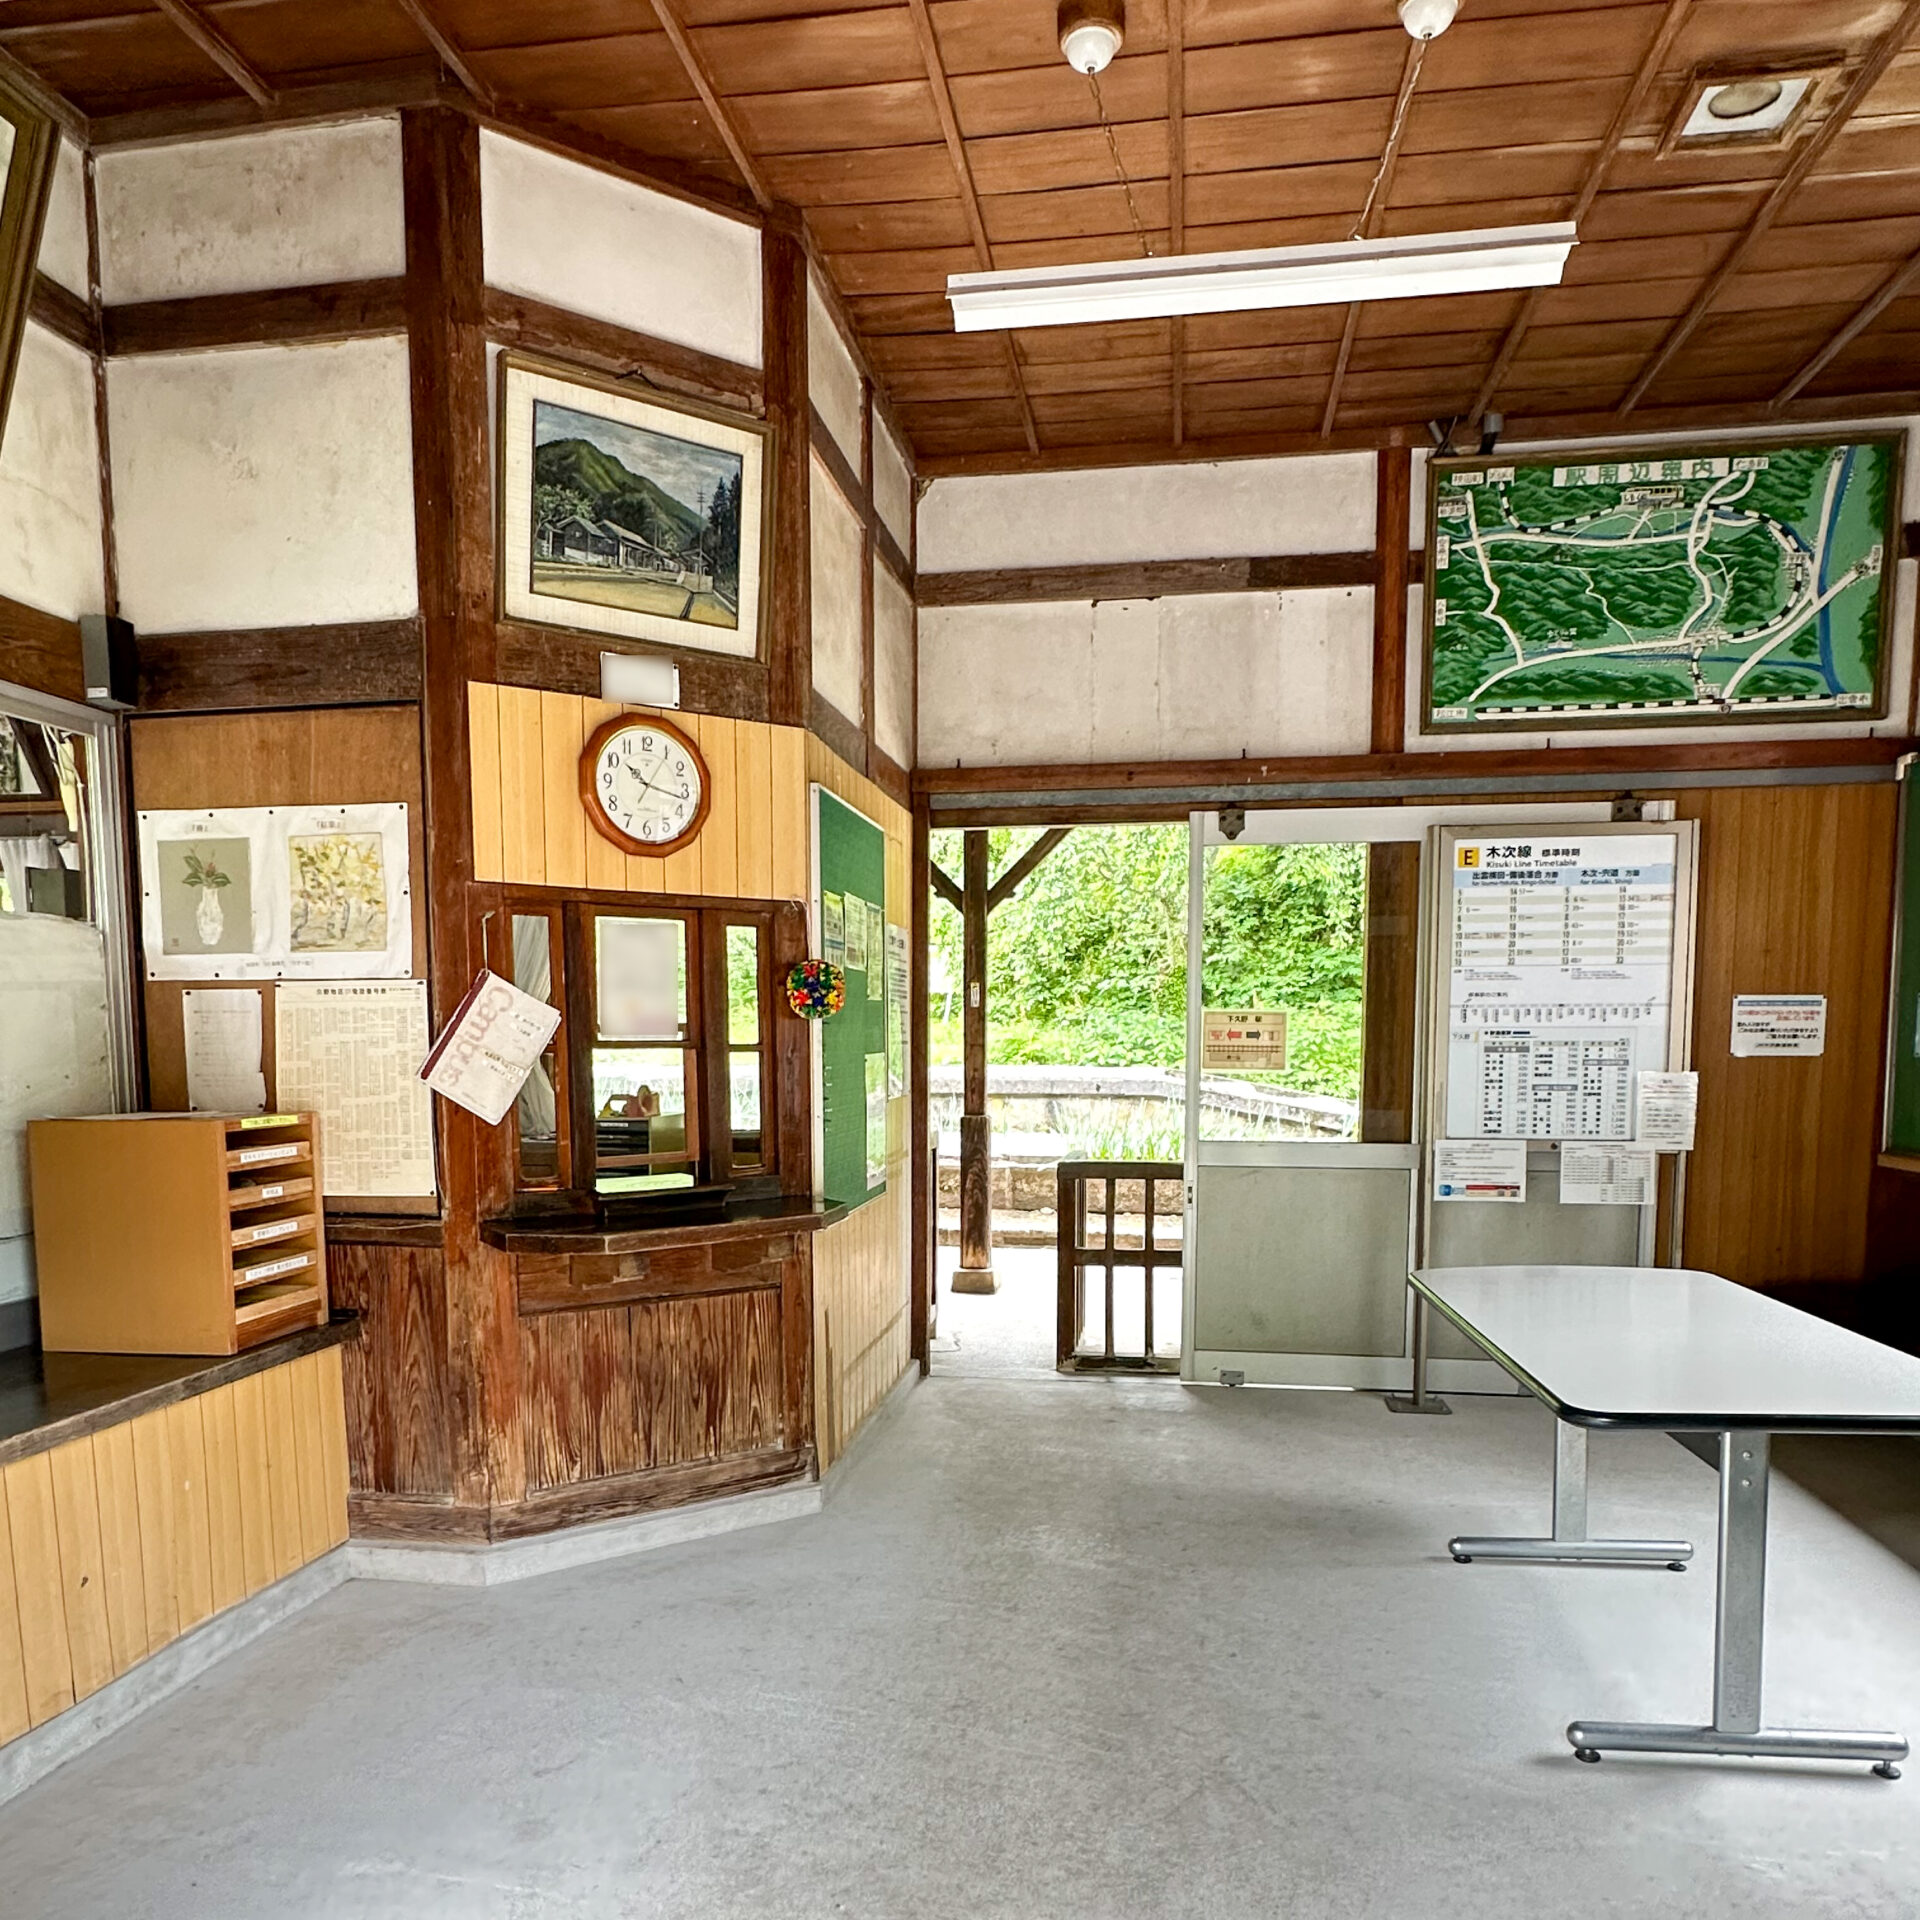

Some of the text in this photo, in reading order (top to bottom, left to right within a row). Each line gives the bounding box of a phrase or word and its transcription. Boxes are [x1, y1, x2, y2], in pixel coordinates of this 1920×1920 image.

[1566, 459, 1713, 486] 駅周辺案内
[623, 738, 631, 754] 11
[642, 736, 653, 752] 12
[608, 752, 619, 768] 10
[665, 745, 668, 760] 1
[676, 761, 684, 776] 2
[603, 774, 612, 789] 9
[681, 784, 689, 799] 3
[609, 795, 617, 811] 8
[675, 804, 684, 819] 4
[623, 814, 632, 828] 7
[662, 818, 670, 832] 5
[643, 820, 651, 838] 6
[1464, 850, 1473, 865] E
[1486, 846, 1532, 858] 木次線
